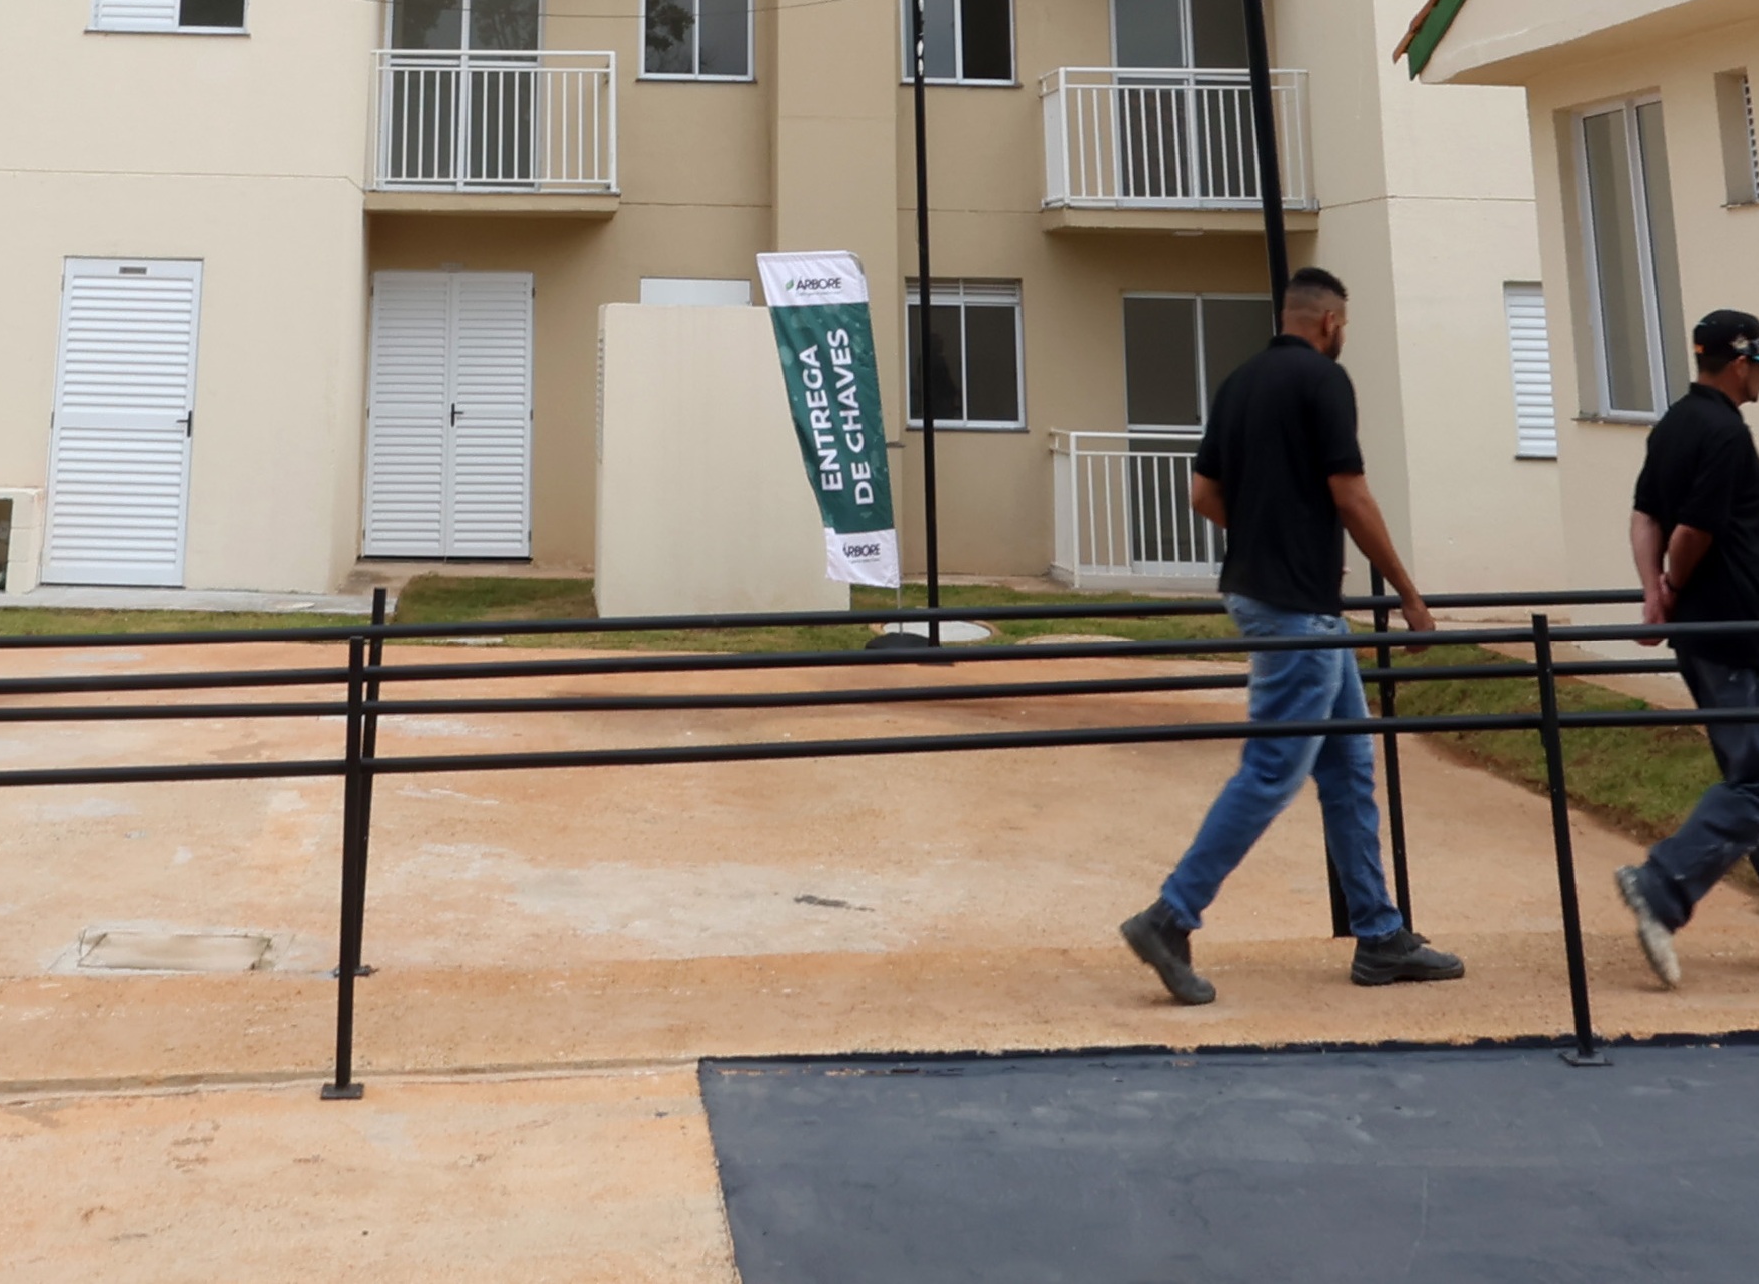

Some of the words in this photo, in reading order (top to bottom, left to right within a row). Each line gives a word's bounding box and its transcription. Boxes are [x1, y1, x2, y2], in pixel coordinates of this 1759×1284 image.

[799, 344, 844, 491] ENTREGA
[826, 328, 866, 454] CHAVES
[850, 461, 875, 505] DE
